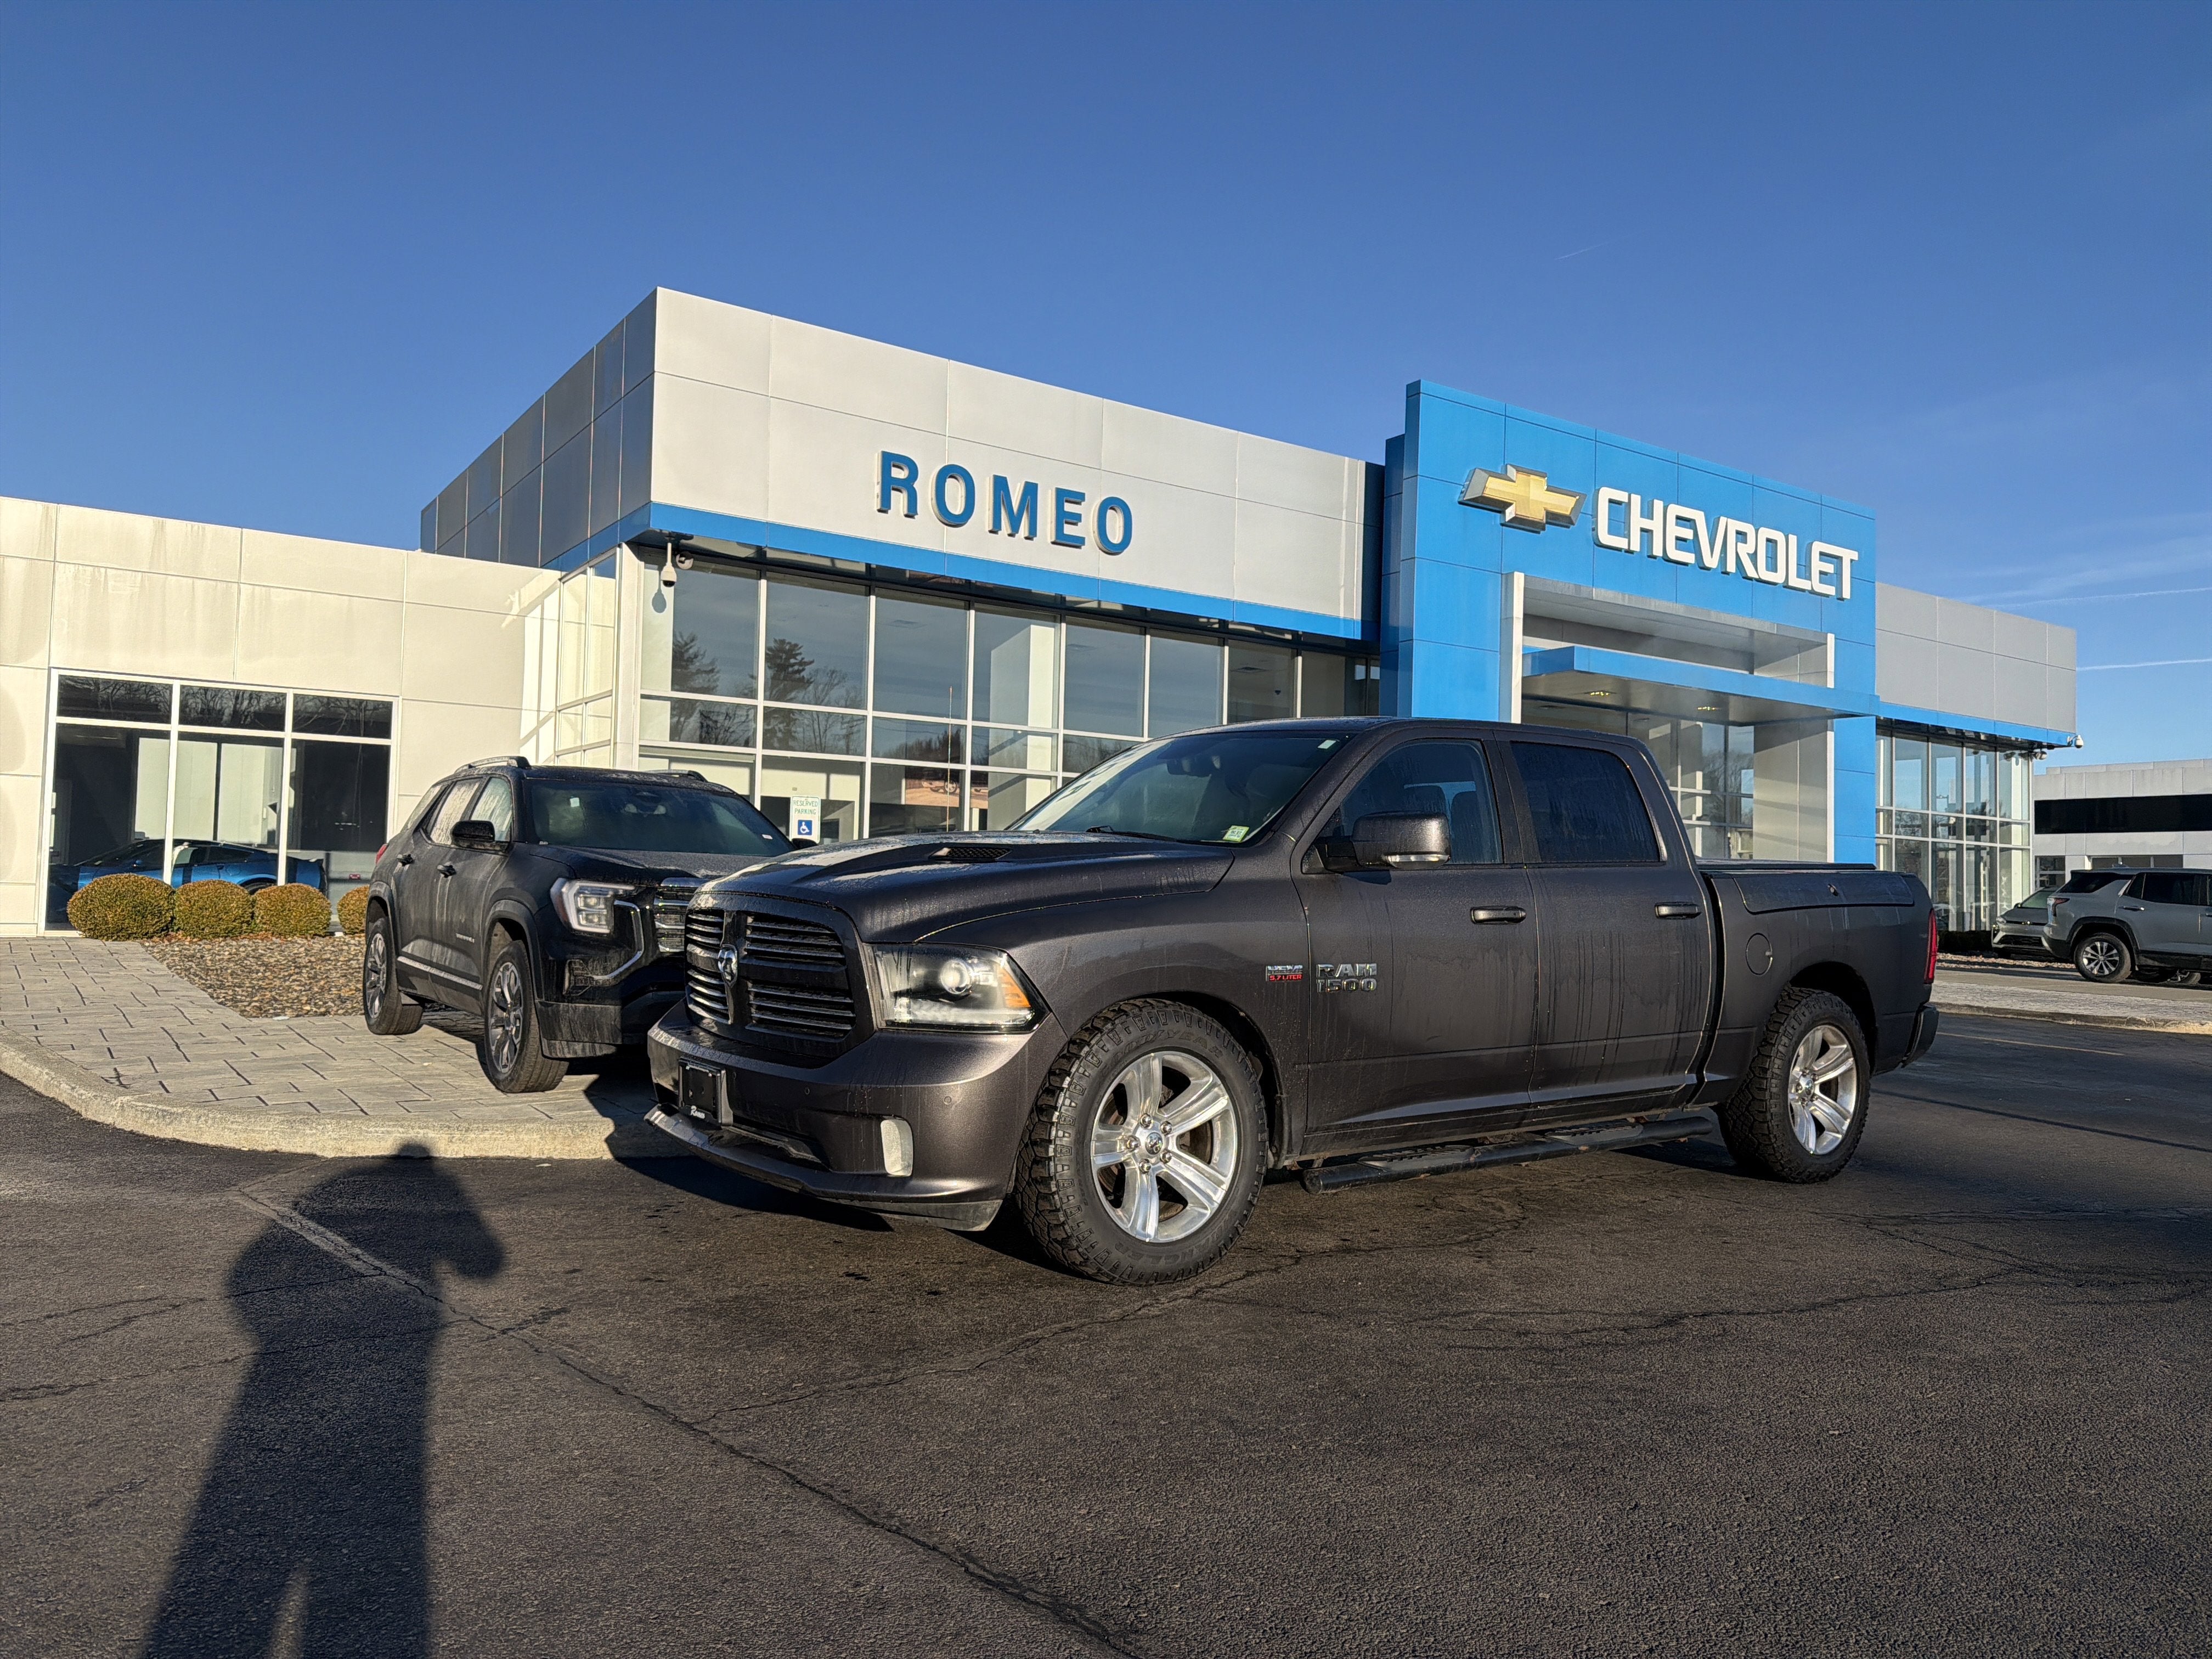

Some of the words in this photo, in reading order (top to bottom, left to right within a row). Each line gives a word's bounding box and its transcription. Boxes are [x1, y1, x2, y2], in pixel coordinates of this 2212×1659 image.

[878, 450, 1132, 554] ROMEO
[1594, 487, 1858, 599] CHEVROLET
[1317, 963, 1376, 977] RAM
[1317, 978, 1376, 992] 1500
